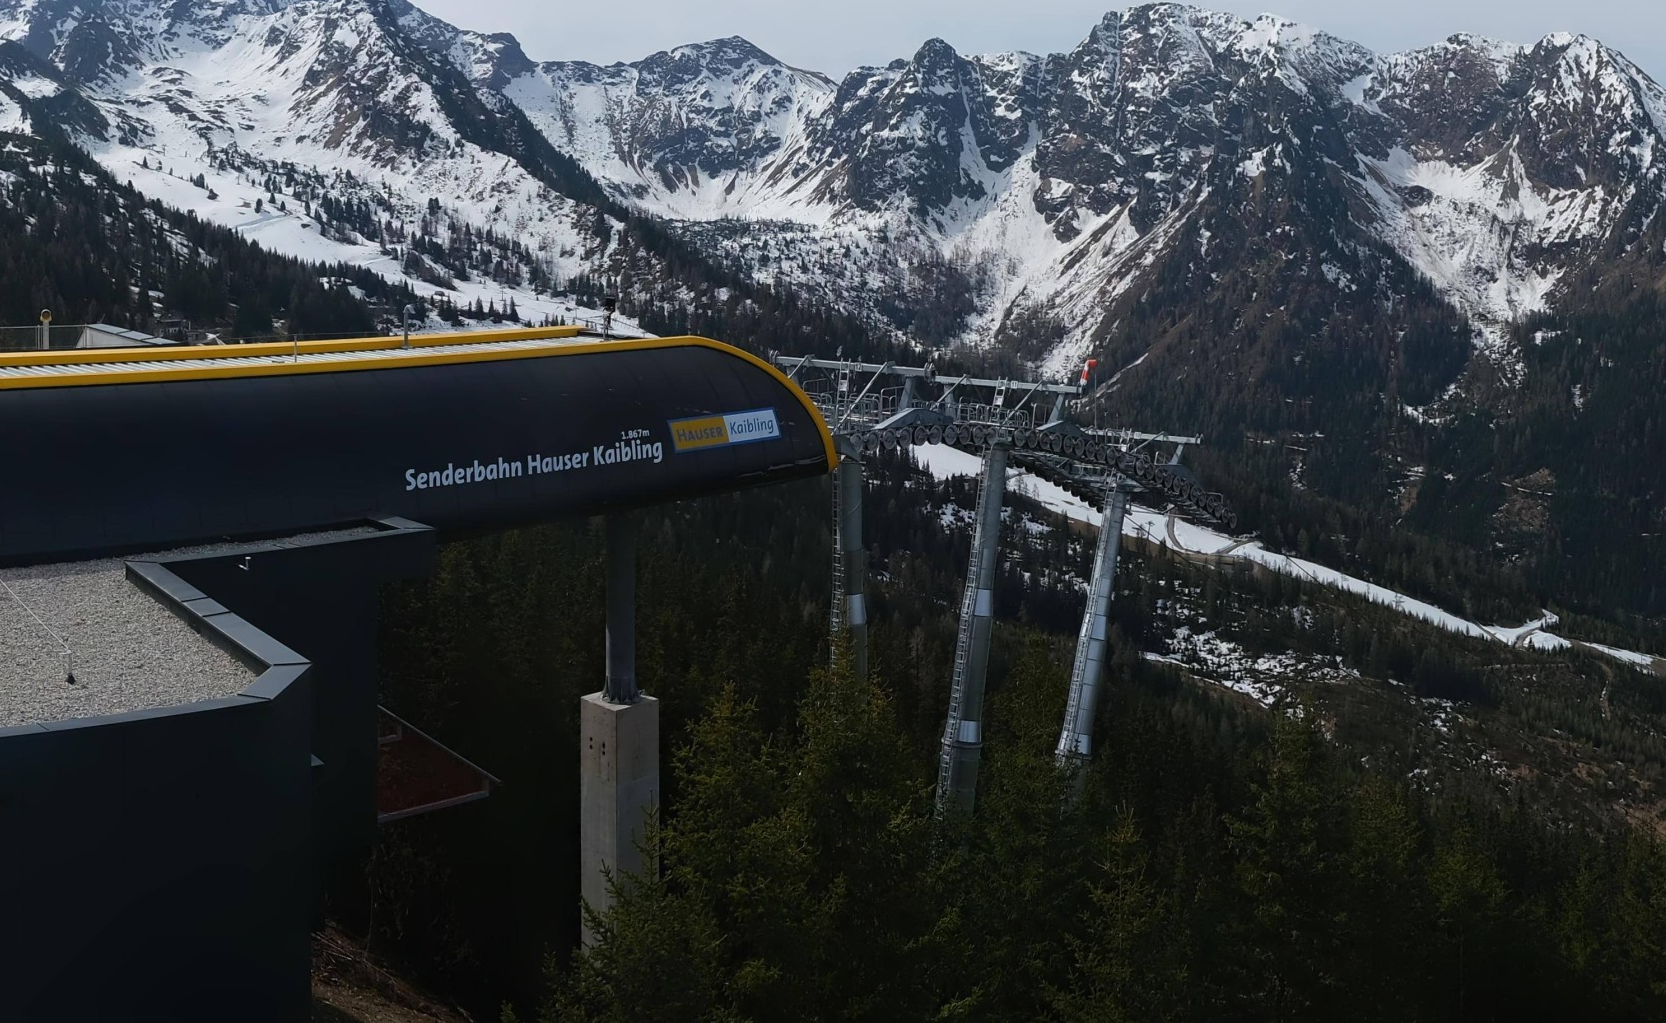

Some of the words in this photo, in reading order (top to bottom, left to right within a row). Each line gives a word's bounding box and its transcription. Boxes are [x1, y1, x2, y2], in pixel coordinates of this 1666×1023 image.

[621, 429, 650, 440] 1.867m
[676, 426, 724, 443] HAUSER
[729, 417, 774, 435] Kaibling
[405, 457, 523, 491] Senderbahn
[527, 451, 589, 475] Hauser
[593, 439, 664, 466] Kaibling
